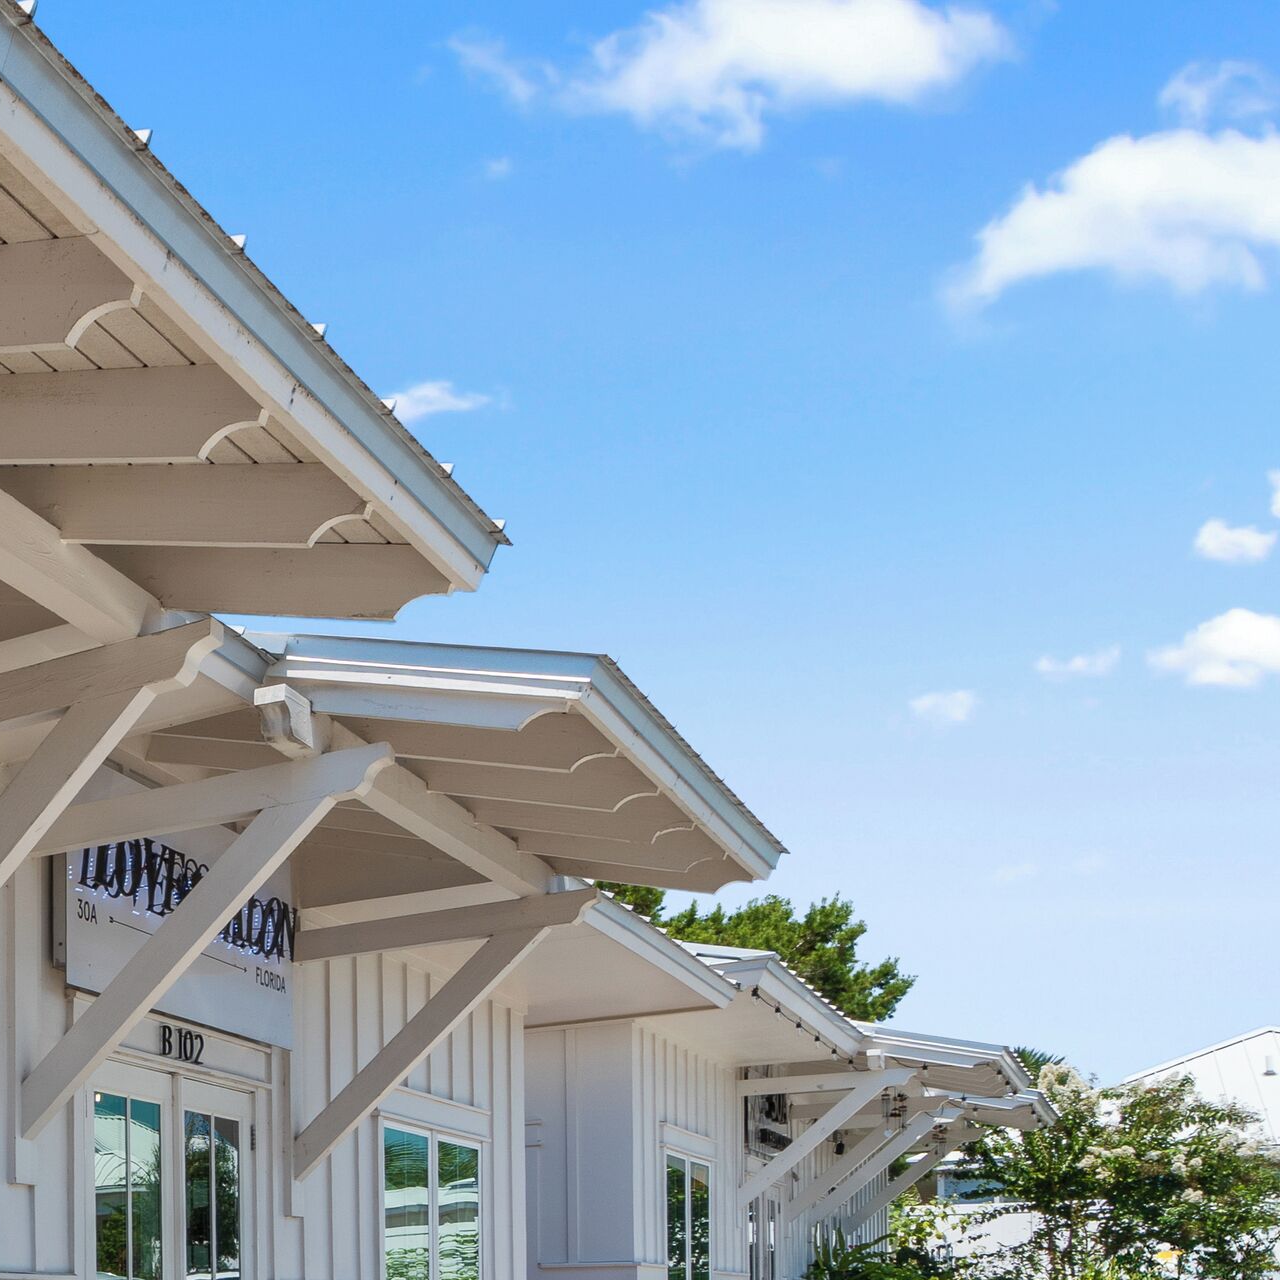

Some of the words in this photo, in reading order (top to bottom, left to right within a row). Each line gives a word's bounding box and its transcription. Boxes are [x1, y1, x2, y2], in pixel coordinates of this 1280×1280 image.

[77, 898, 98, 925] 30A
[255, 966, 287, 994] FLORIDA
[161, 1025, 173, 1056] B
[176, 1028, 205, 1065] 102
